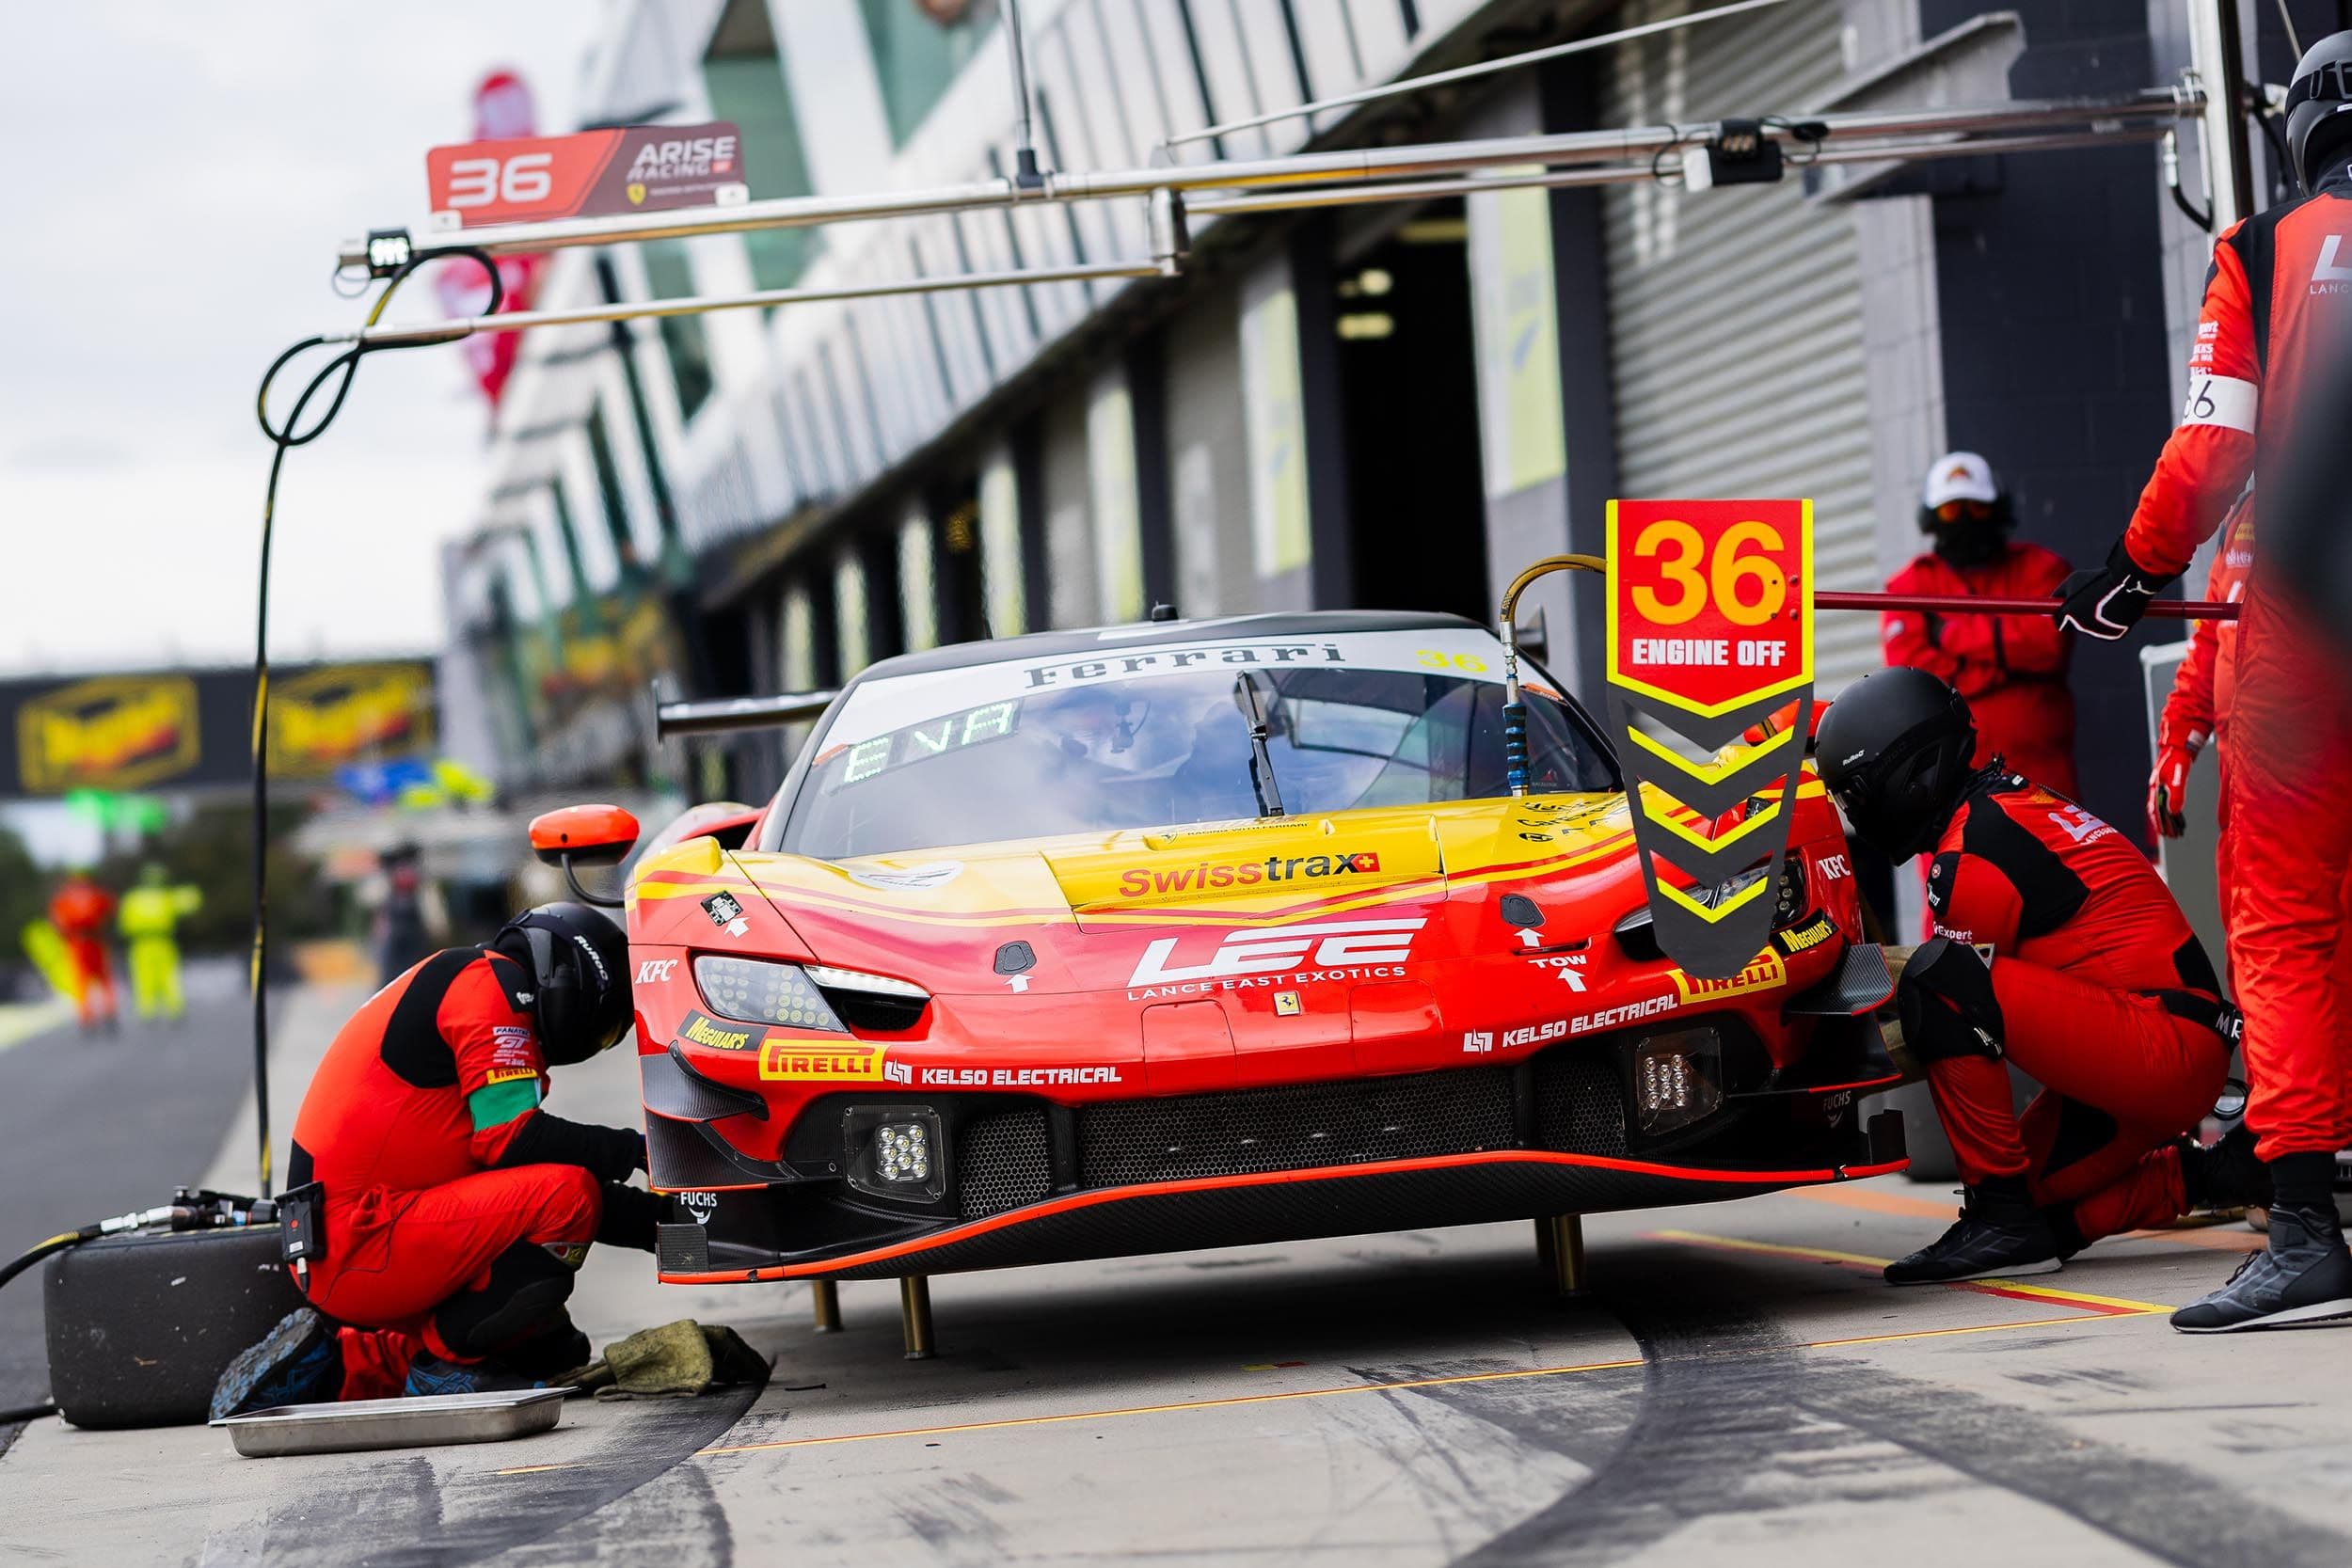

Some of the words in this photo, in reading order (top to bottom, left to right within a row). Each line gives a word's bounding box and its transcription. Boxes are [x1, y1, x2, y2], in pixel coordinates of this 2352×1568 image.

[634, 136, 736, 166] ARISE
[448, 154, 553, 208] 36
[627, 162, 710, 182] RACING
[1631, 519, 1787, 626] 36
[1024, 643, 1346, 689] Ferrari
[1416, 649, 1487, 673] 36
[1632, 639, 1729, 665] ENGINE
[1738, 641, 1786, 666] OFF
[844, 702, 1013, 784] EVA
[1119, 852, 1359, 898] Swisstrax
[1819, 854, 1851, 880] KFC
[1126, 918, 1428, 988] LEE
[1528, 955, 1587, 969] TOW
[634, 958, 678, 986] KFC
[1127, 981, 1214, 1002] LANCE
[1222, 974, 1285, 991] EAST
[1295, 966, 1406, 985] EXOTICS
[1502, 1020, 1566, 1049] KELSO
[1570, 993, 1678, 1035] ELECTRICAL
[767, 1045, 876, 1075] PIRELLI
[921, 1067, 988, 1086] KELSO
[992, 1066, 1122, 1086] ELECTRICAL
[1823, 1090, 1851, 1112] FUCHS
[680, 1191, 718, 1208] FUCHS
